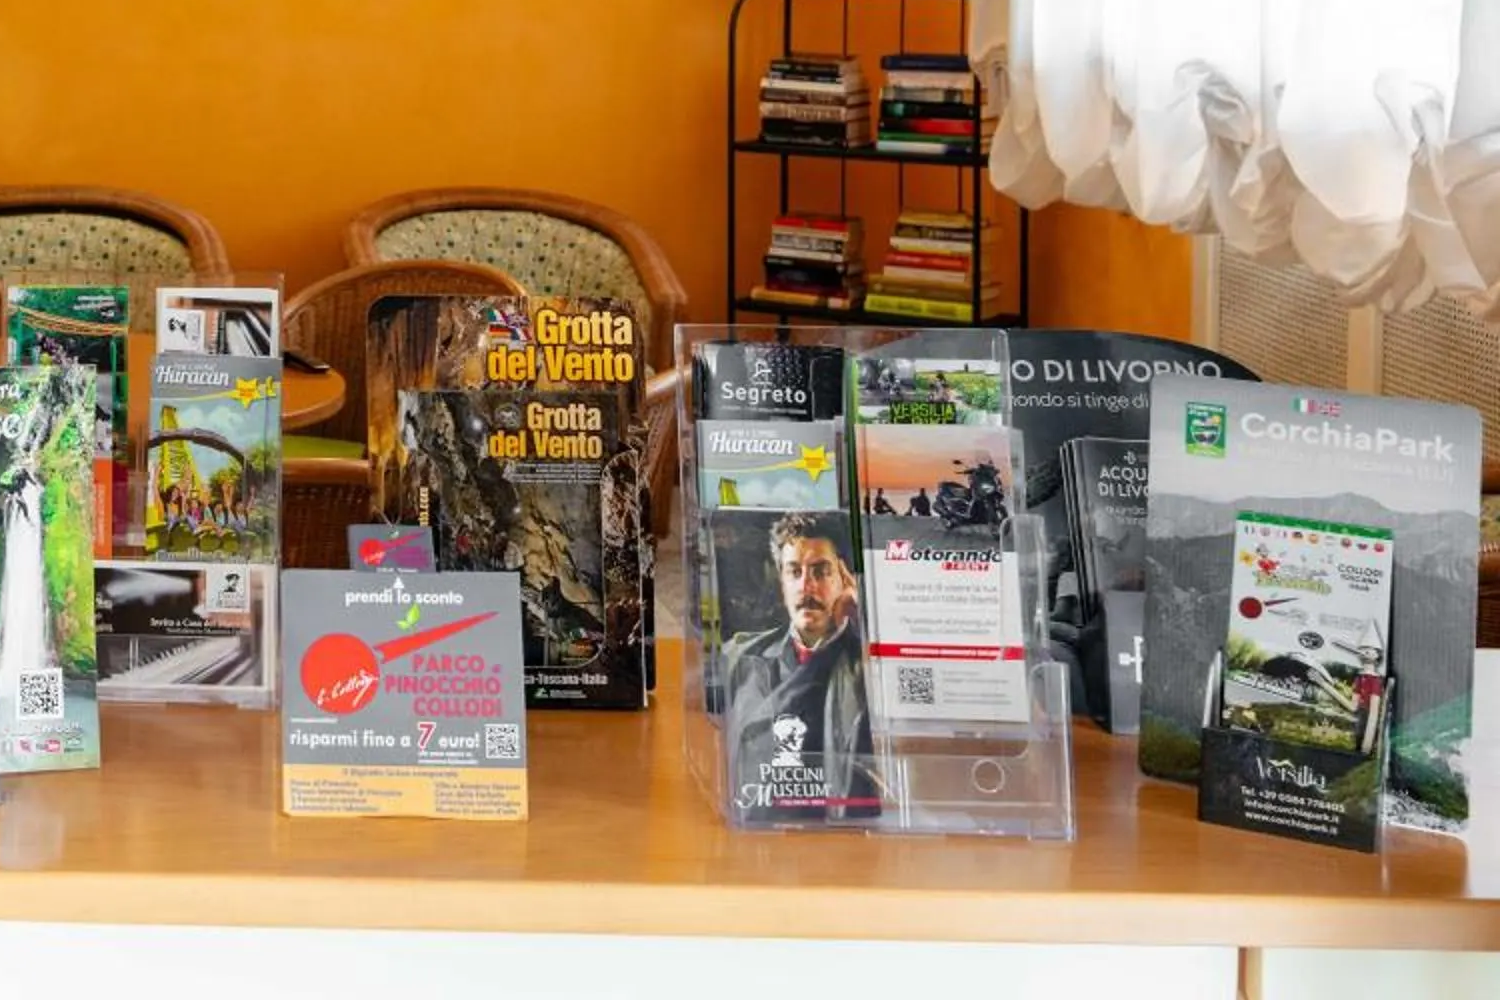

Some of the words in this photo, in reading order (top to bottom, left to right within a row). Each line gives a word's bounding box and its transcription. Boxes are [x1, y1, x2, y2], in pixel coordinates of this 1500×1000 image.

[536, 308, 634, 346] Grotta
[487, 345, 536, 382] del
[539, 348, 635, 383] Vento
[1043, 359, 1074, 382] DI
[156, 366, 229, 386] Huracan
[721, 381, 807, 405] Segreto
[1067, 392, 1082, 407] si
[1084, 392, 1129, 413] tinge
[1132, 392, 1148, 408] di
[526, 401, 602, 431] Grotta
[891, 403, 954, 418] VERSILIA
[489, 430, 526, 458] del
[533, 431, 603, 459] Vento
[709, 430, 794, 455] Huracan
[1241, 412, 1457, 463] CorchiaPark
[1100, 467, 1149, 483] ACQU
[1098, 482, 1114, 497] DI
[345, 589, 393, 607] prendi
[397, 588, 411, 605] lo
[414, 591, 464, 605] sconto
[412, 654, 485, 675] PARCO
[385, 675, 501, 695] PINOCCHIO
[413, 697, 502, 718] COLLODI
[290, 730, 358, 751] risparmi
[362, 729, 395, 748] fino
[400, 735, 411, 748] a
[417, 721, 436, 752] 7
[438, 732, 481, 749] euro!
[759, 763, 824, 782] PUCCINI
[733, 782, 832, 808] MUSEUM
